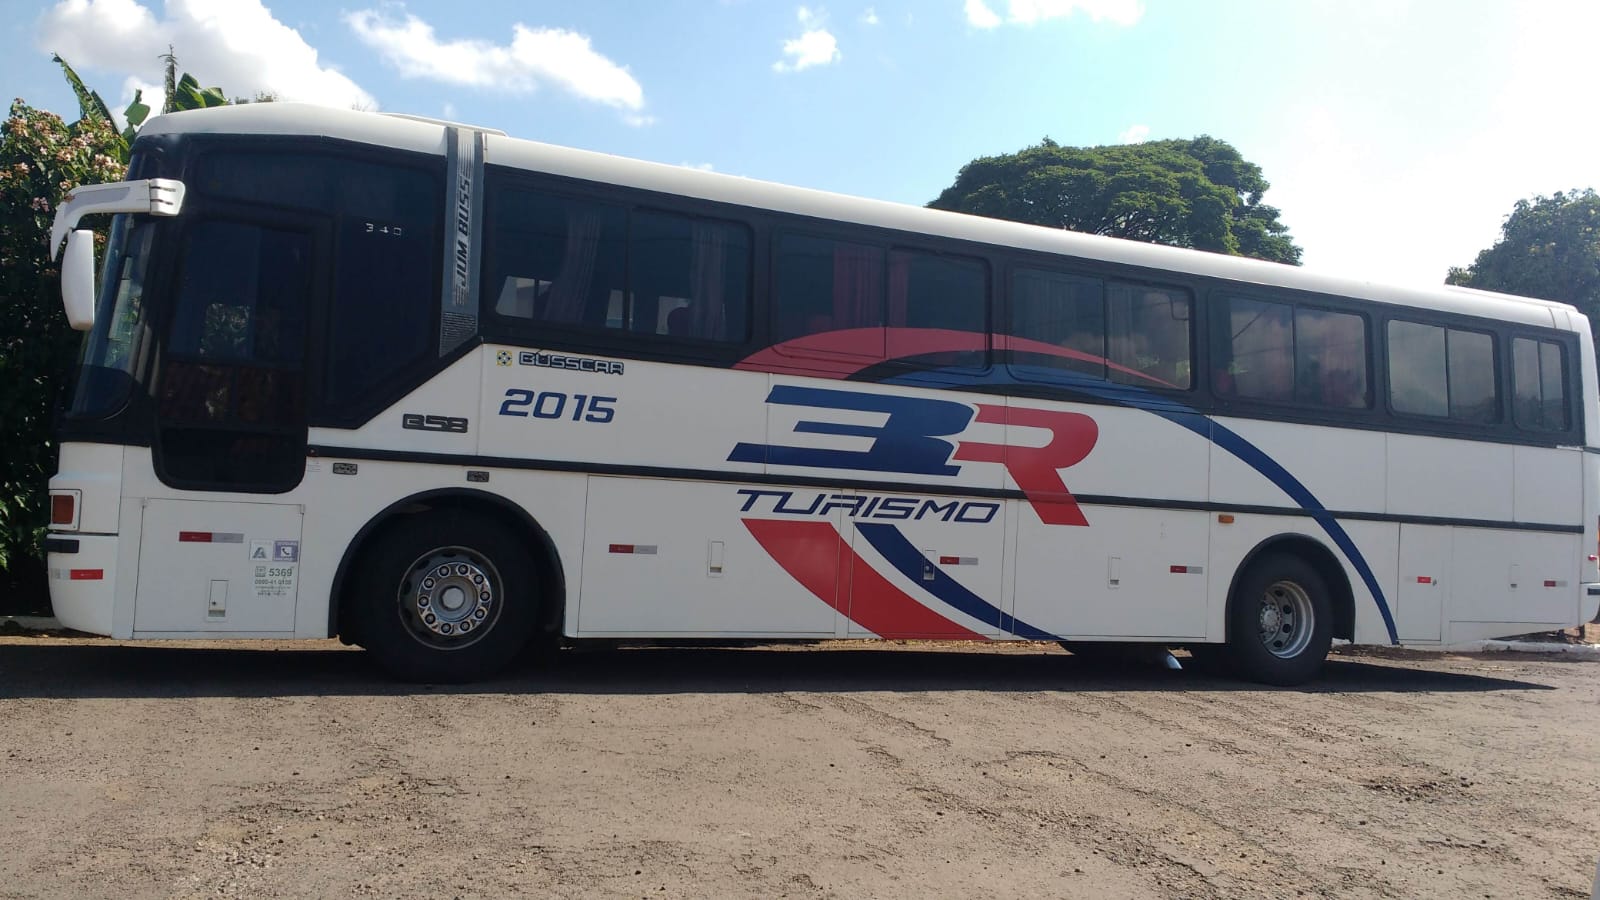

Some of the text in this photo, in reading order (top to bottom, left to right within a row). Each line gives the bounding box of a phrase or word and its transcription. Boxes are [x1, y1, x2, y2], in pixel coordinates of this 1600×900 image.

[456, 174, 471, 287] JUM BUSS
[519, 352, 624, 375] BUSSCAR
[499, 388, 617, 423] 2015
[402, 413, 468, 433] B58
[737, 489, 1000, 523] TURISMO
[269, 568, 293, 577] 5369
